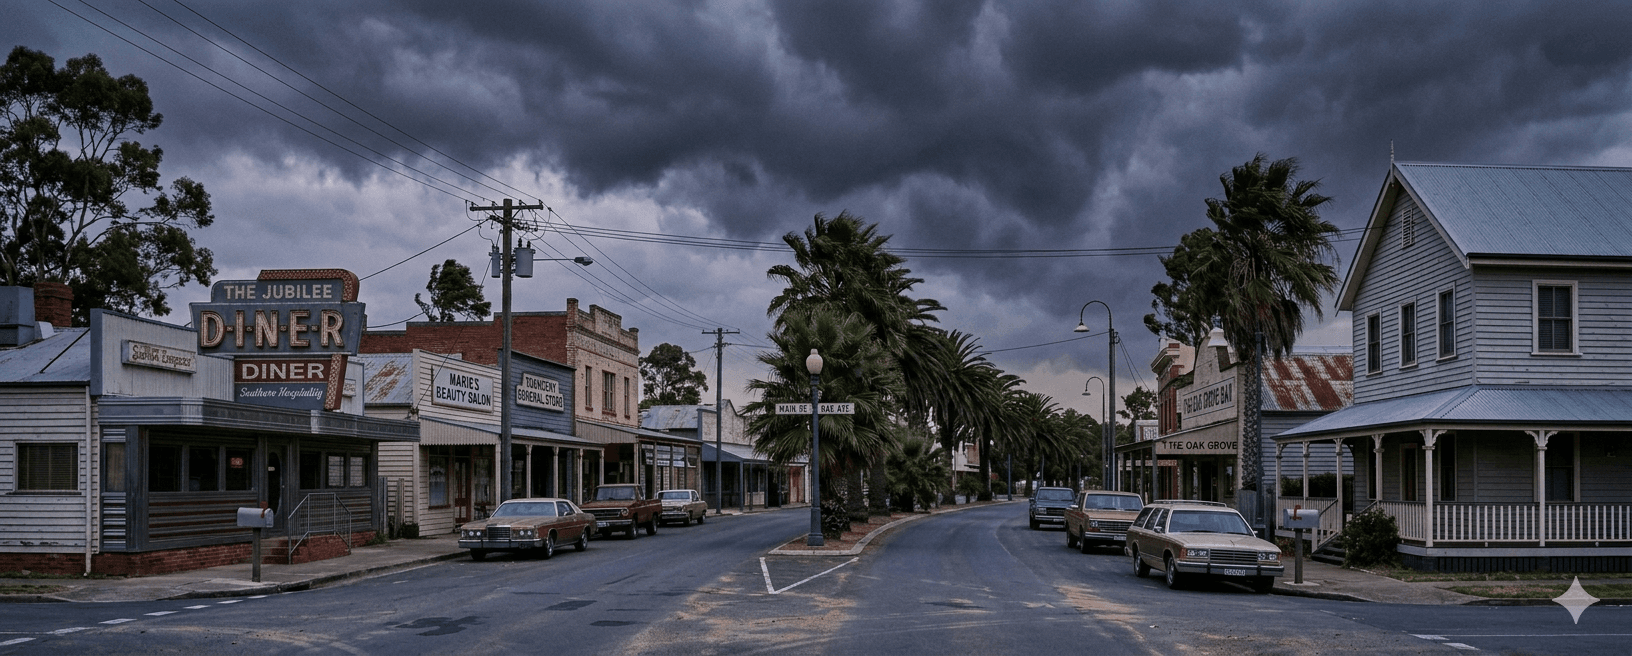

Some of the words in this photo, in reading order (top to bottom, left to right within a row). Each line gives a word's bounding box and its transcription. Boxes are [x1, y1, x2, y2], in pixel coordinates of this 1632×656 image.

[224, 285, 256, 299] THE
[262, 284, 333, 299] JUBILEE
[241, 363, 325, 380] DINER
[436, 386, 466, 402] BEAUTY
[468, 391, 491, 406] SALON
[1186, 441, 1205, 450] OAK
